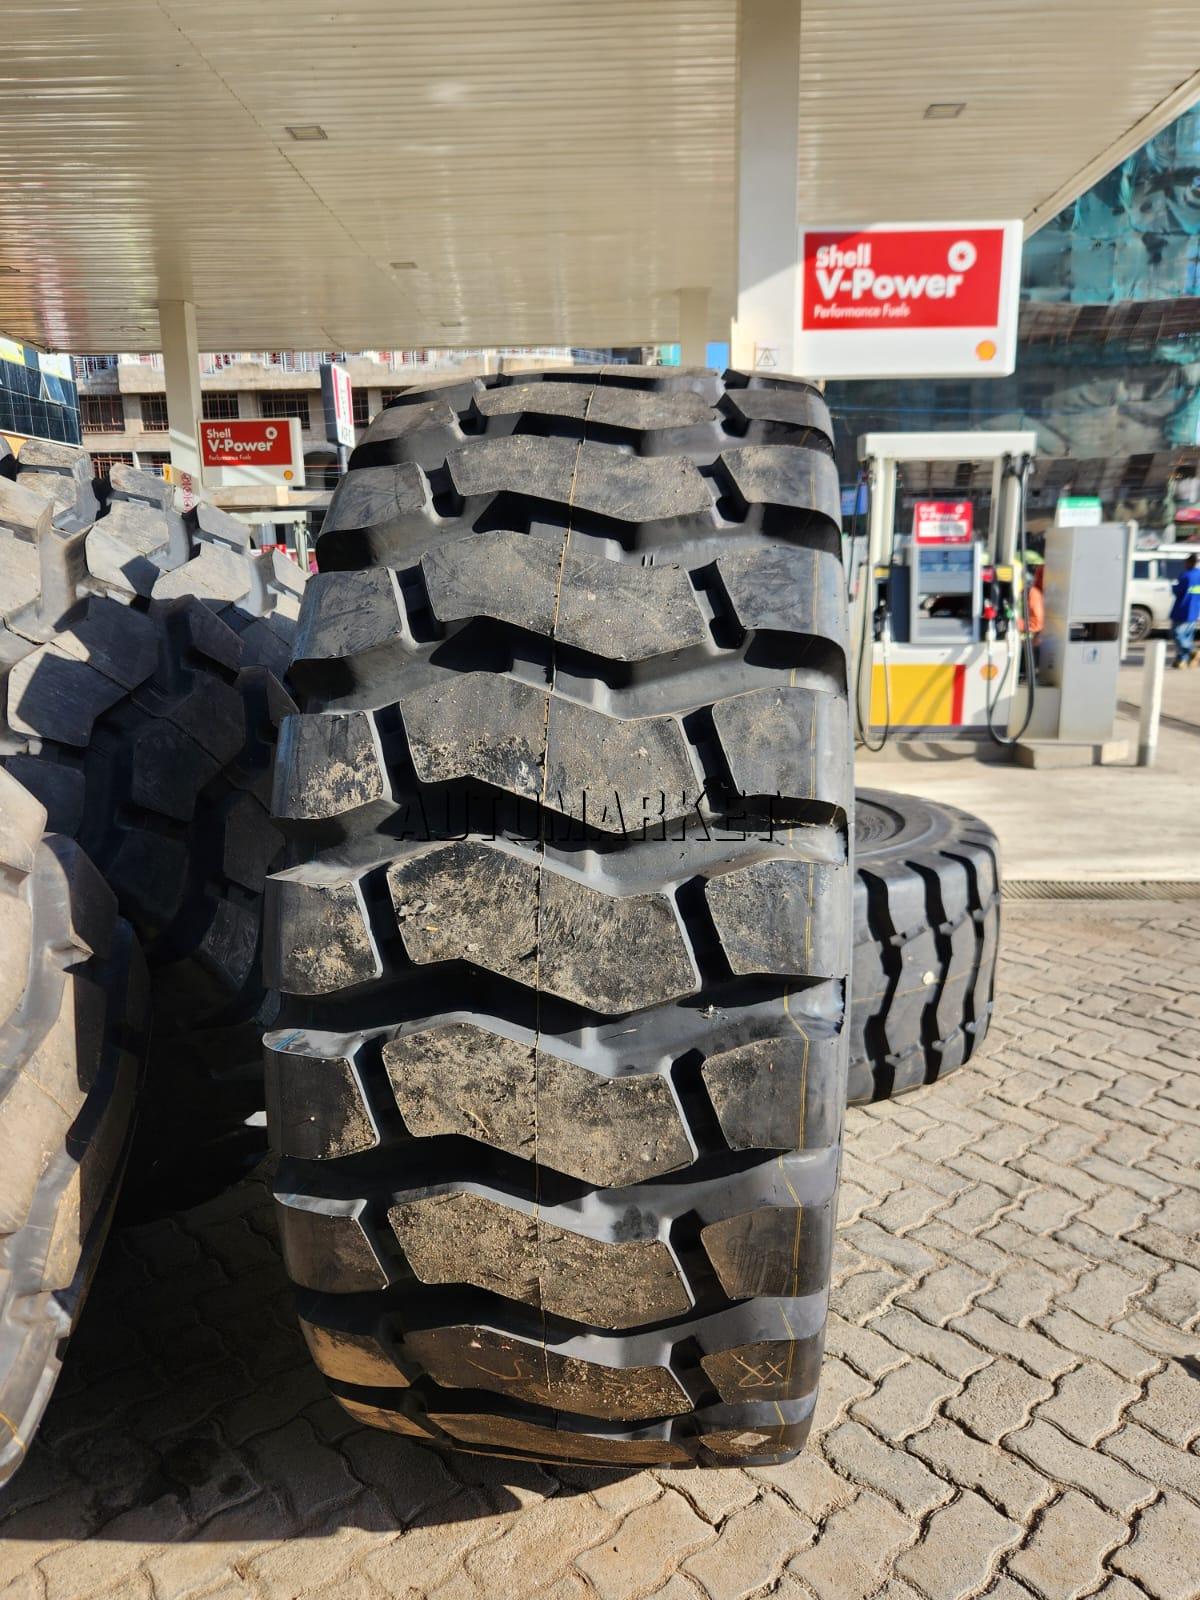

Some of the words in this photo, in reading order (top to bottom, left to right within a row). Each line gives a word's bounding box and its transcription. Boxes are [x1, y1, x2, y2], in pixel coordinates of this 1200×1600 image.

[815, 242, 872, 269] Shell
[815, 268, 964, 300] V-Power
[813, 303, 881, 319] Performance
[882, 301, 911, 318] Fuels
[206, 428, 231, 439] Shell
[207, 439, 274, 453] V-Power
